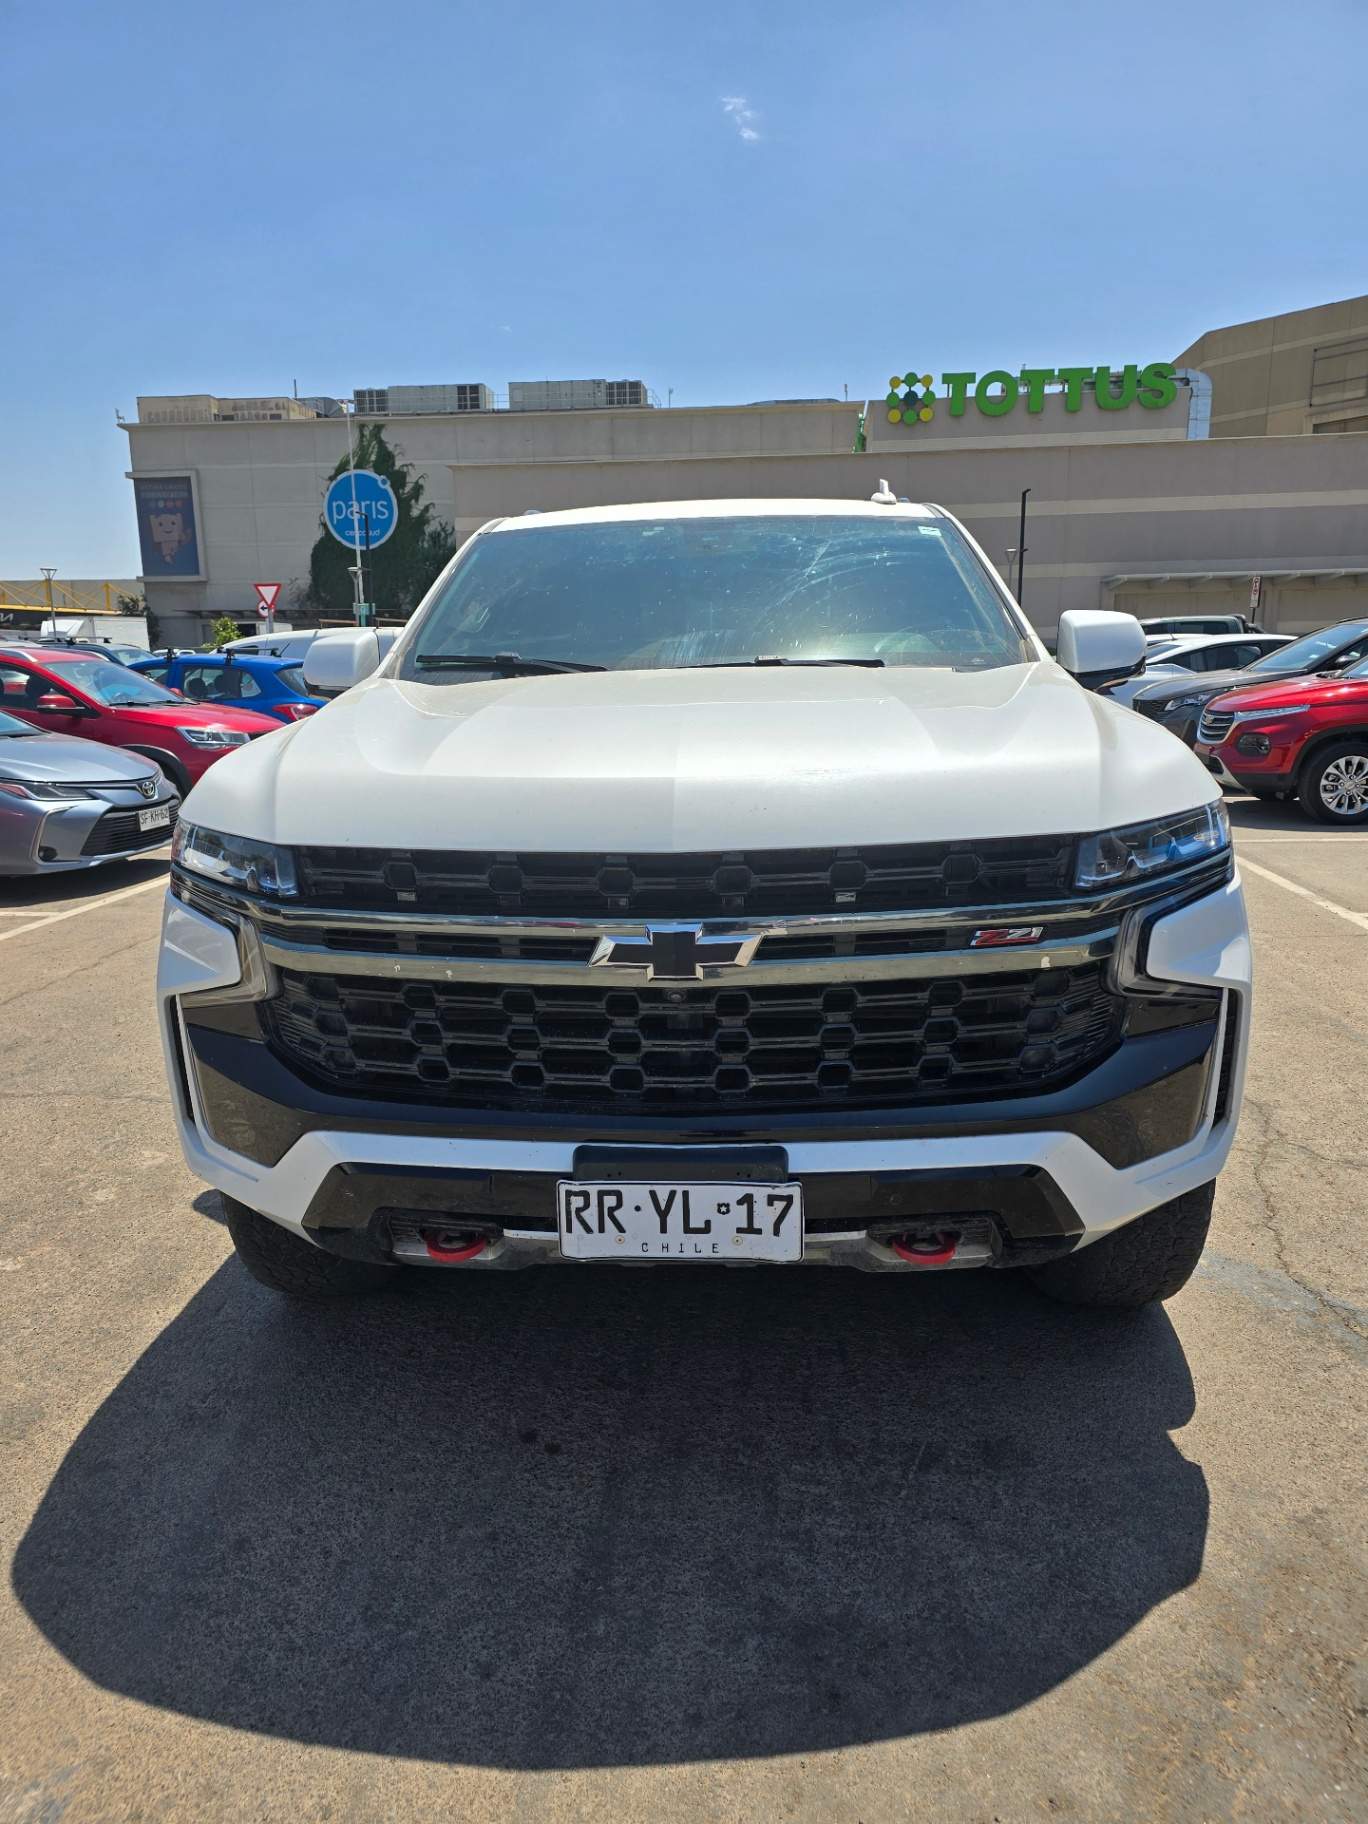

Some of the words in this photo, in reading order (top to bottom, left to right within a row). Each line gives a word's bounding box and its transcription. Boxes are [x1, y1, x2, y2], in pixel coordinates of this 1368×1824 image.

[942, 362, 1177, 417] TOTTUS
[332, 500, 389, 525] paris
[970, 926, 1044, 946] Z71
[641, 1242, 720, 1253] CHILE
